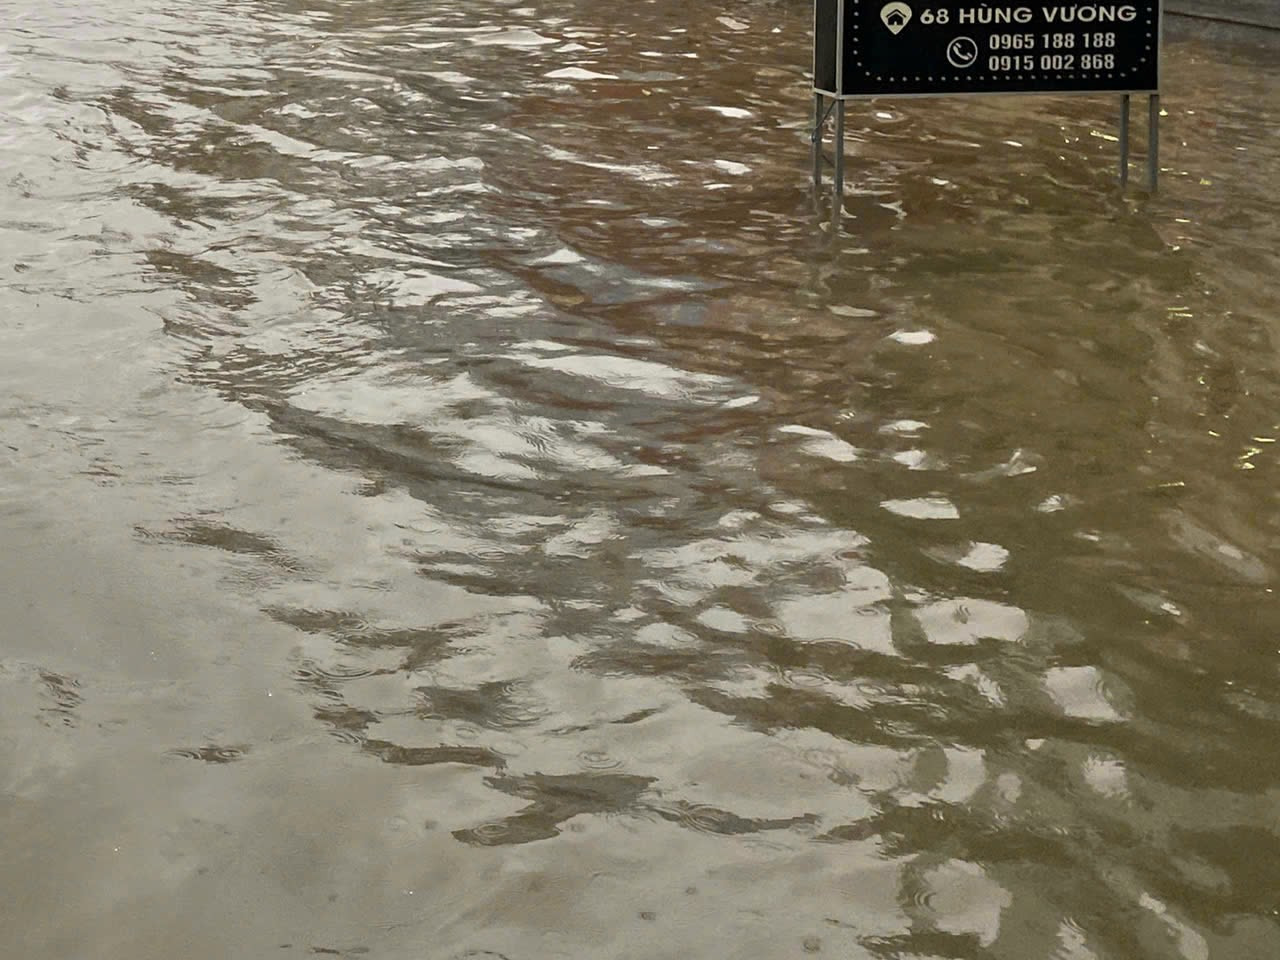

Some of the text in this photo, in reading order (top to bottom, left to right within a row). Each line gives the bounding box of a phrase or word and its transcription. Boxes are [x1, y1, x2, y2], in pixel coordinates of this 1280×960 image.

[919, 2, 1138, 25] 68 HÙNG VƯƠNG
[988, 32, 1116, 50] 0965 188 188
[988, 54, 1115, 71] 0915 002 868
